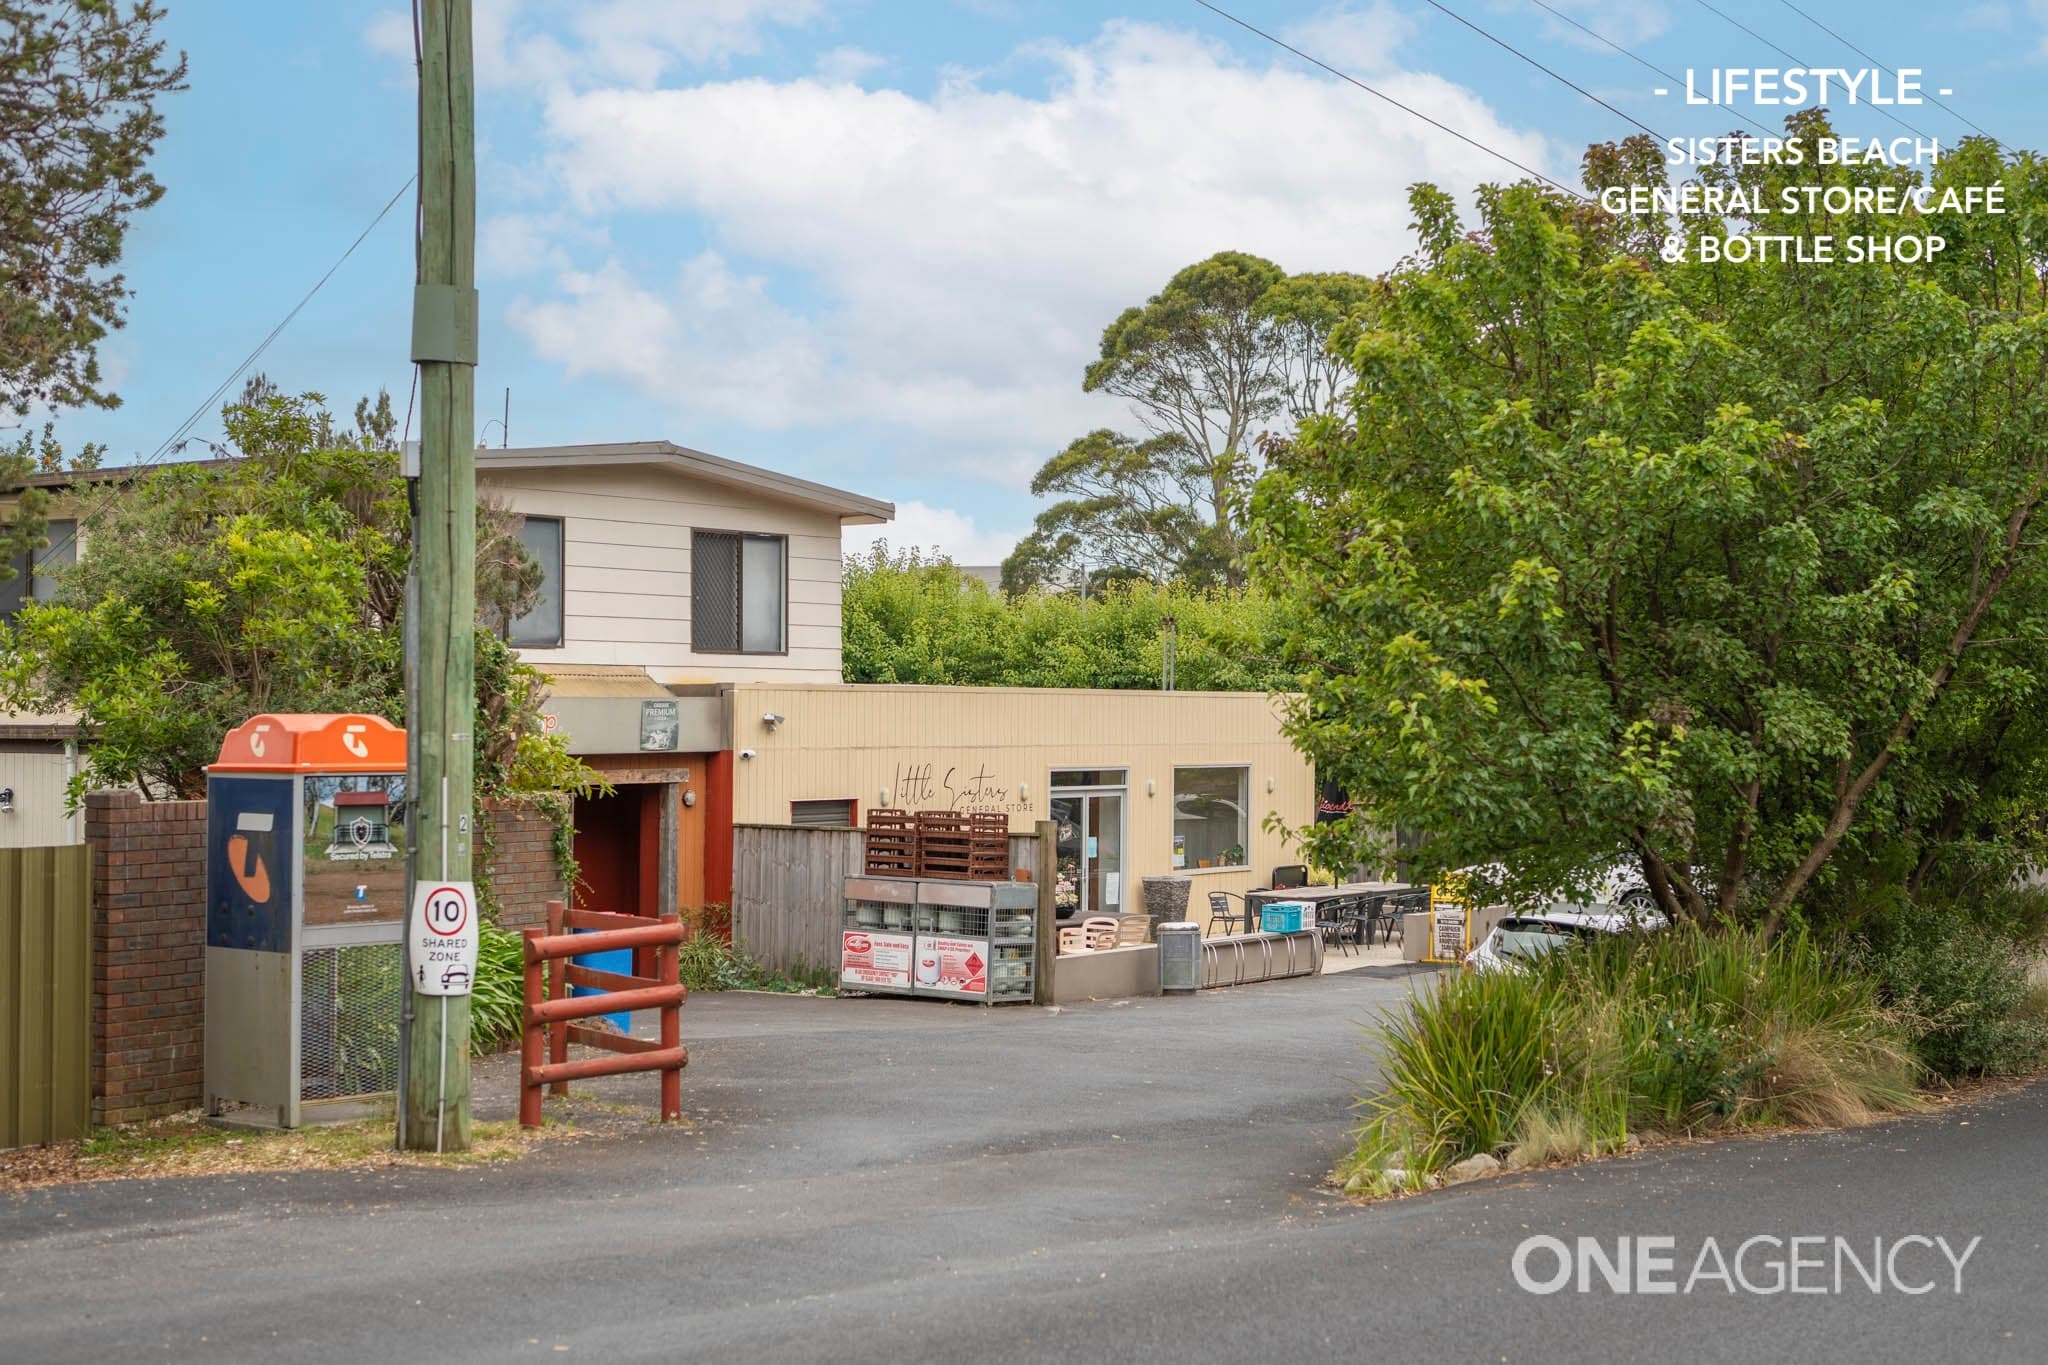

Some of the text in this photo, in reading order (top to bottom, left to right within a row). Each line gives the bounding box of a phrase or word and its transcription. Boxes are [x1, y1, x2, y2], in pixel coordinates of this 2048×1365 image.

[645, 708, 676, 716] PREMIUM
[943, 762, 1009, 811] Sisters
[959, 803, 1034, 814] GENERAL STORE
[330, 852, 360, 861] Secured
[360, 852, 369, 862] by
[433, 900, 460, 922] 10
[422, 938, 468, 949] SHARED
[429, 951, 462, 962] ZONE
